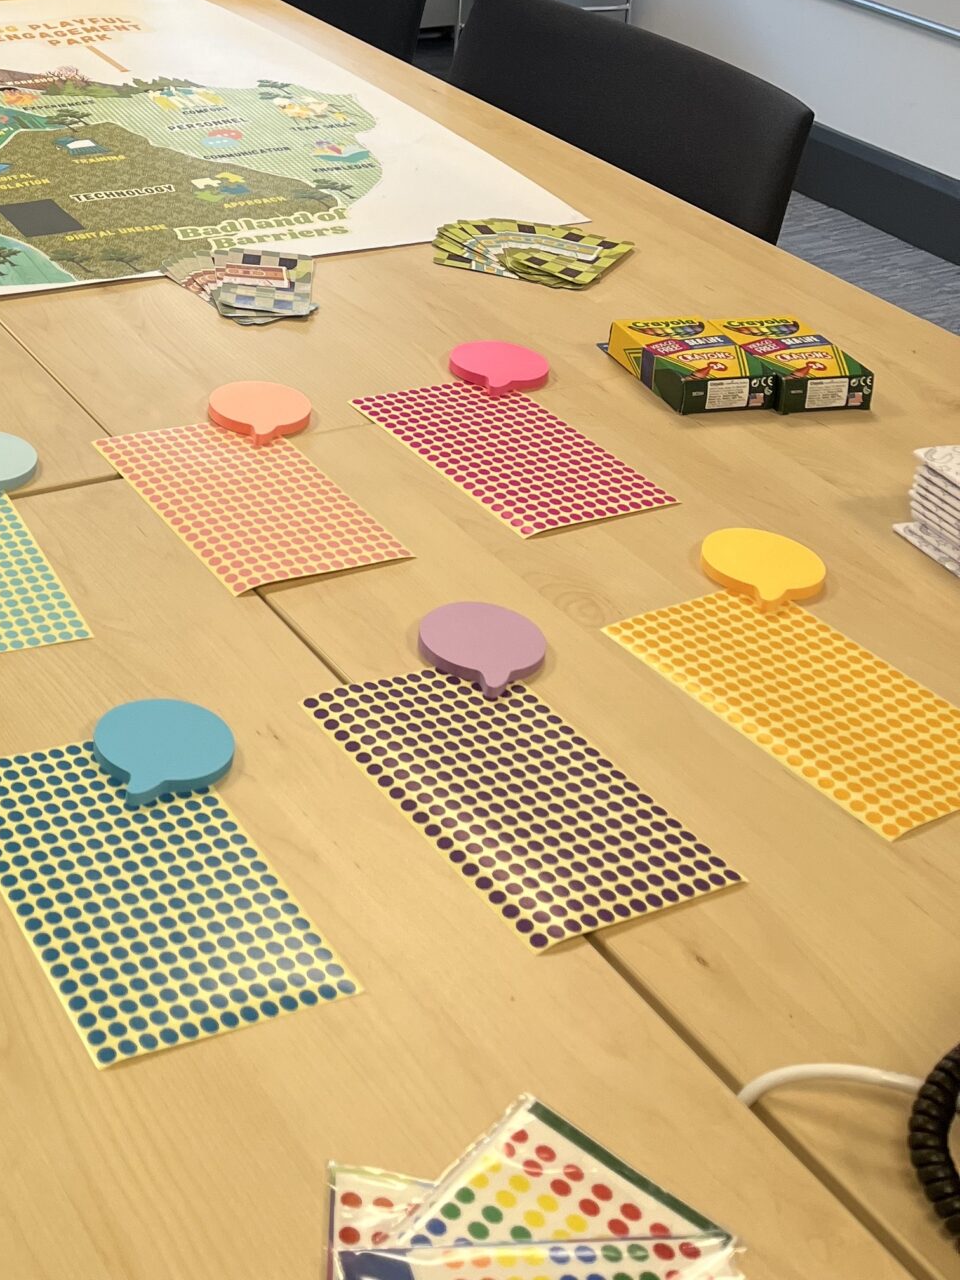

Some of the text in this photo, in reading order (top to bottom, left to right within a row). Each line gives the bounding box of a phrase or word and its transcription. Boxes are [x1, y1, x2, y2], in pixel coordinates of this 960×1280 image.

[28, 17, 132, 31] PLAYFUL
[47, 34, 112, 47] PARK
[22, 100, 95, 111] EXPERIENCES
[168, 118, 248, 132] PERSONNEL
[72, 155, 127, 165] TRAINING
[203, 146, 292, 161] COMMUNICATION
[72, 185, 175, 203] TECHNOLOGY
[224, 196, 287, 209] APPROACH
[317, 208, 347, 222] of
[65, 229, 117, 242] DIGITAL
[212, 225, 349, 249] Barriers
[632, 319, 695, 328] Crayola
[727, 318, 791, 328] Crayola
[678, 352, 735, 362] CRAYONS
[776, 351, 832, 362] CRAYONS
[712, 362, 725, 370] 24
[811, 361, 825, 370] 24
